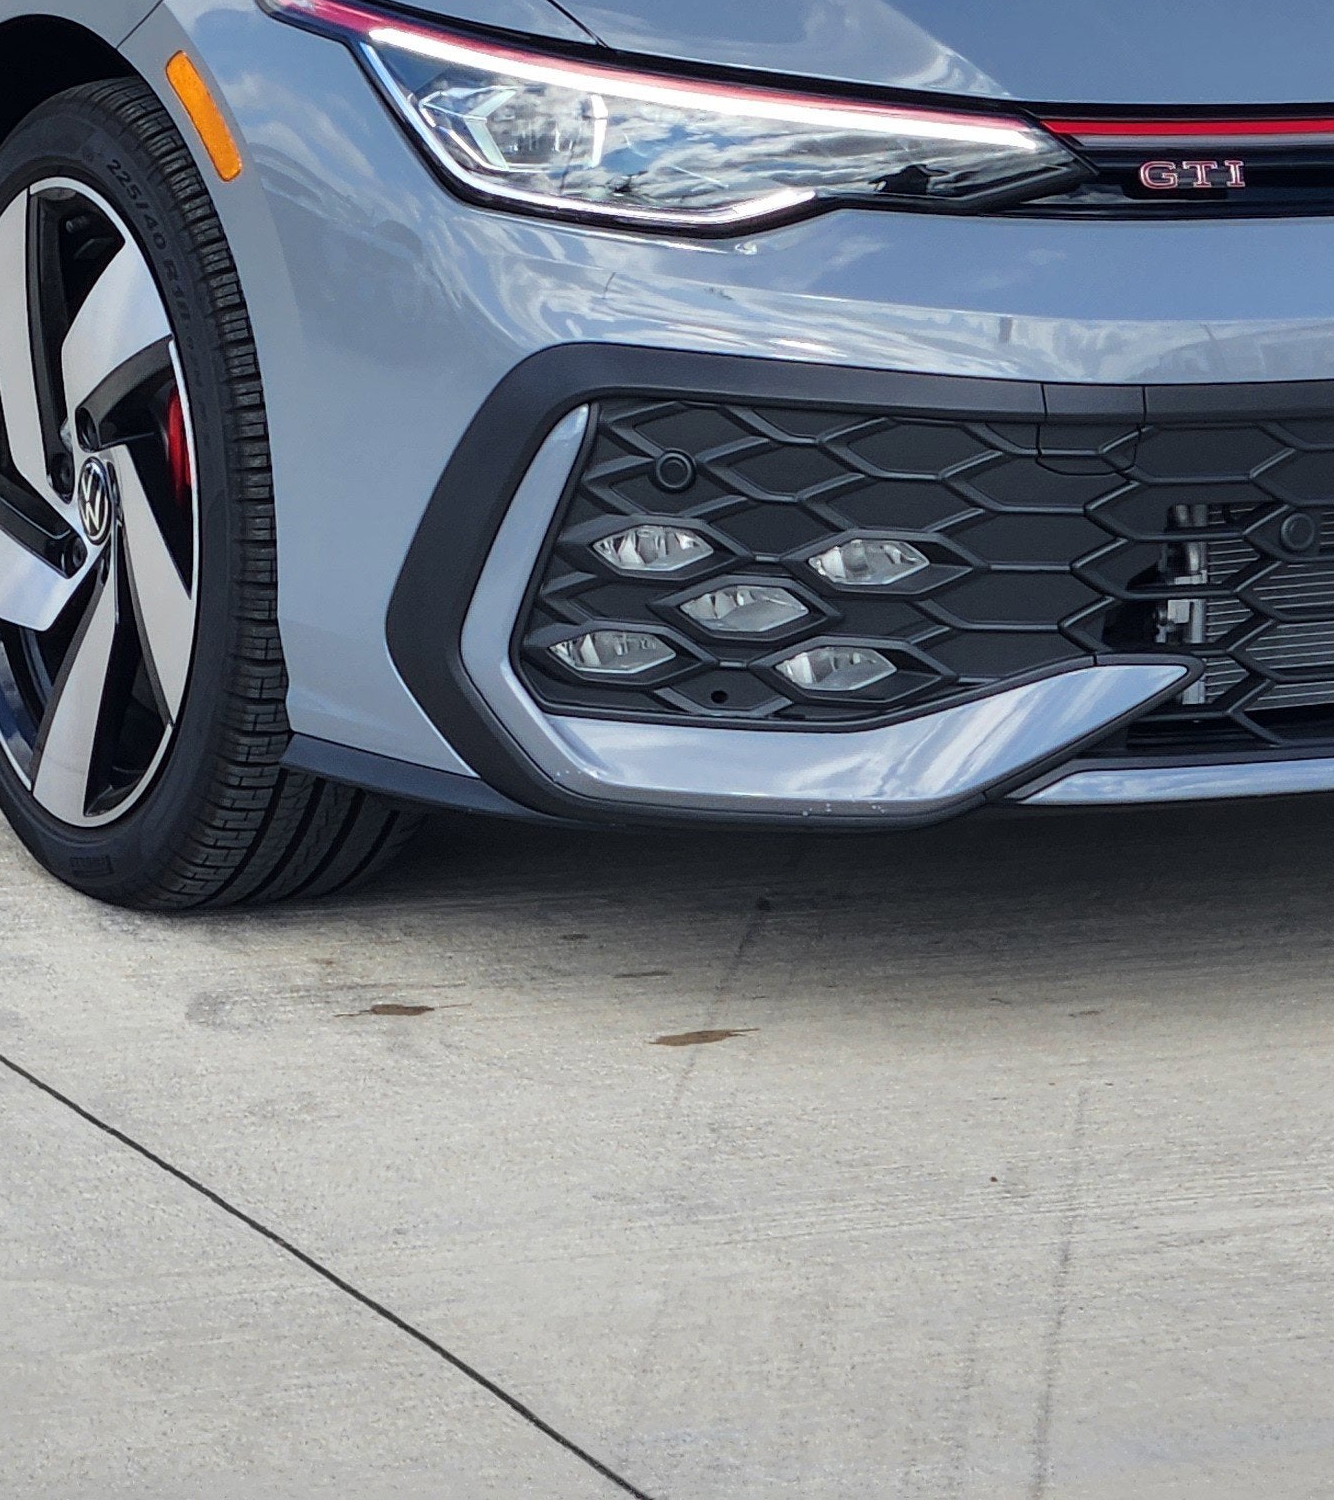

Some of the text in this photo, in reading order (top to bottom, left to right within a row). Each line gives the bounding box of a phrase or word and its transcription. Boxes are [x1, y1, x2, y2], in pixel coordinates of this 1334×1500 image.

[106, 158, 166, 250] 225/40
[1140, 160, 1246, 190] GTI
[80, 463, 108, 540] VW
